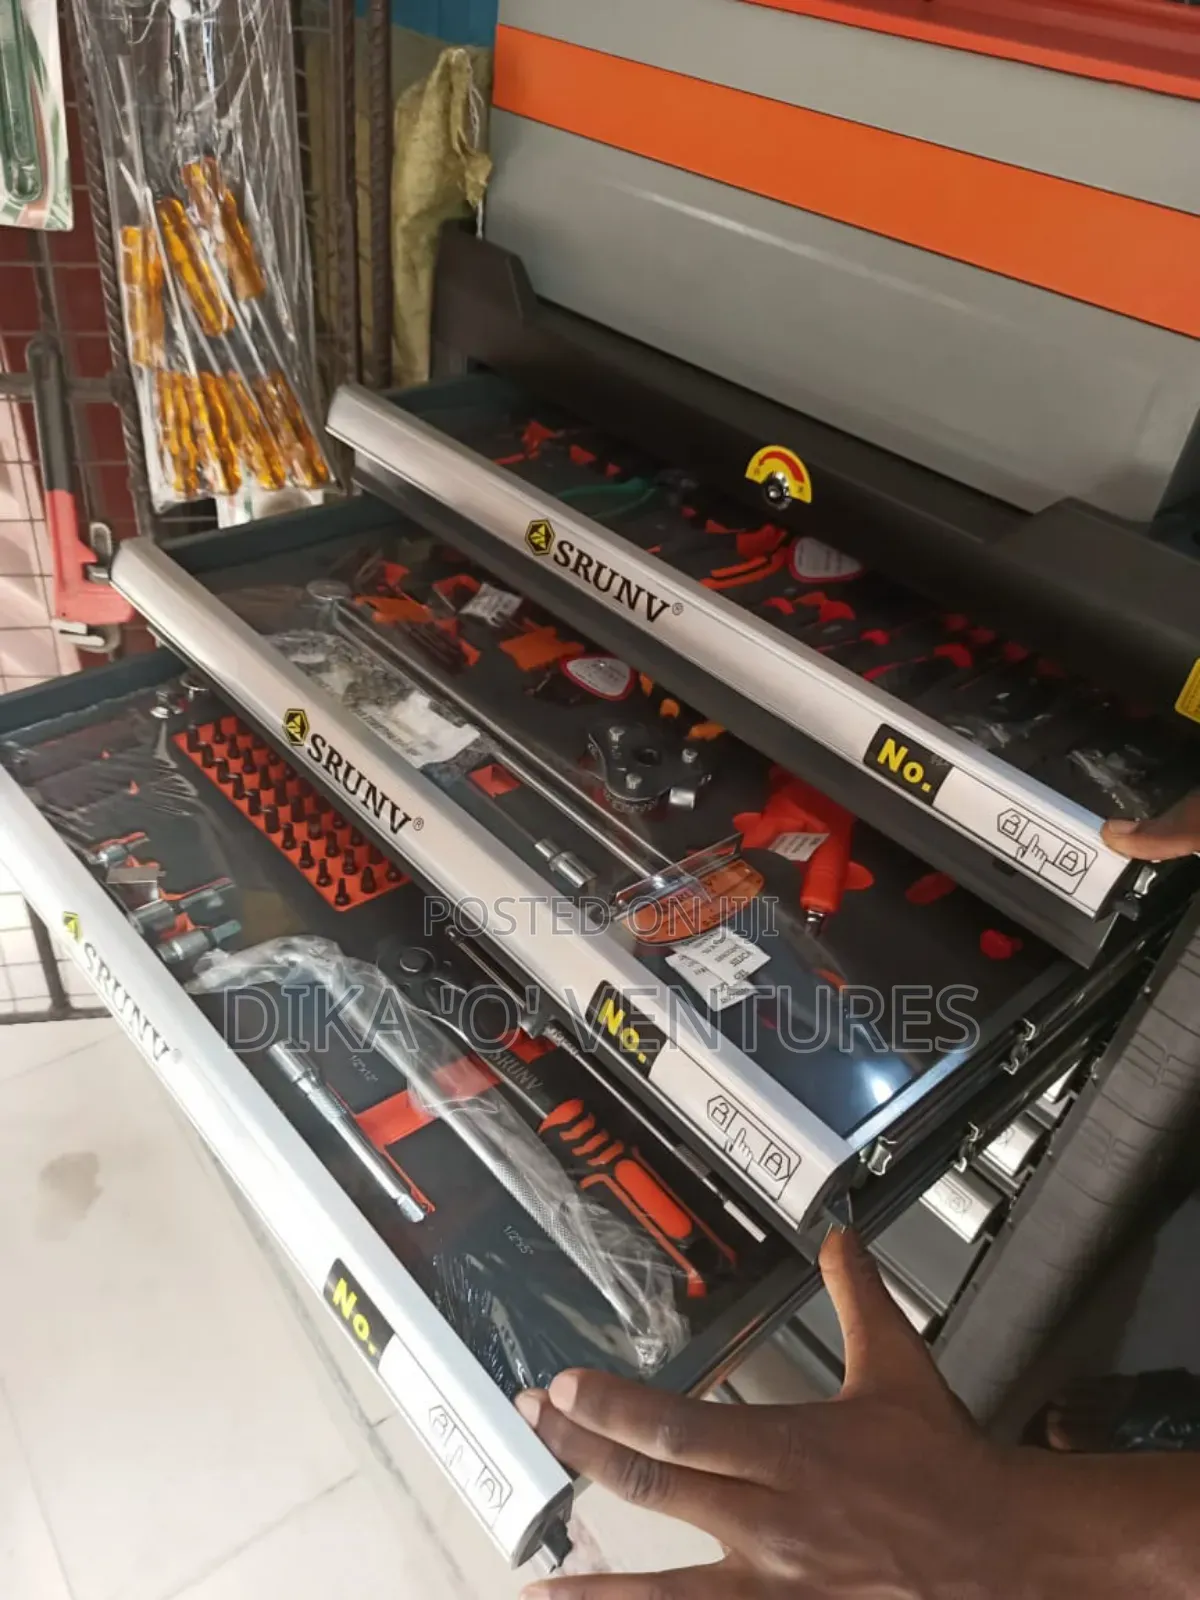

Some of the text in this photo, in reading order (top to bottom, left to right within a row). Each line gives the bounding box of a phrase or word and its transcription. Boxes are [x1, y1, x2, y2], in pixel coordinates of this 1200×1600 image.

[877, 737, 932, 793] No.
[598, 998, 647, 1064] No.
[333, 1277, 377, 1356] No.
